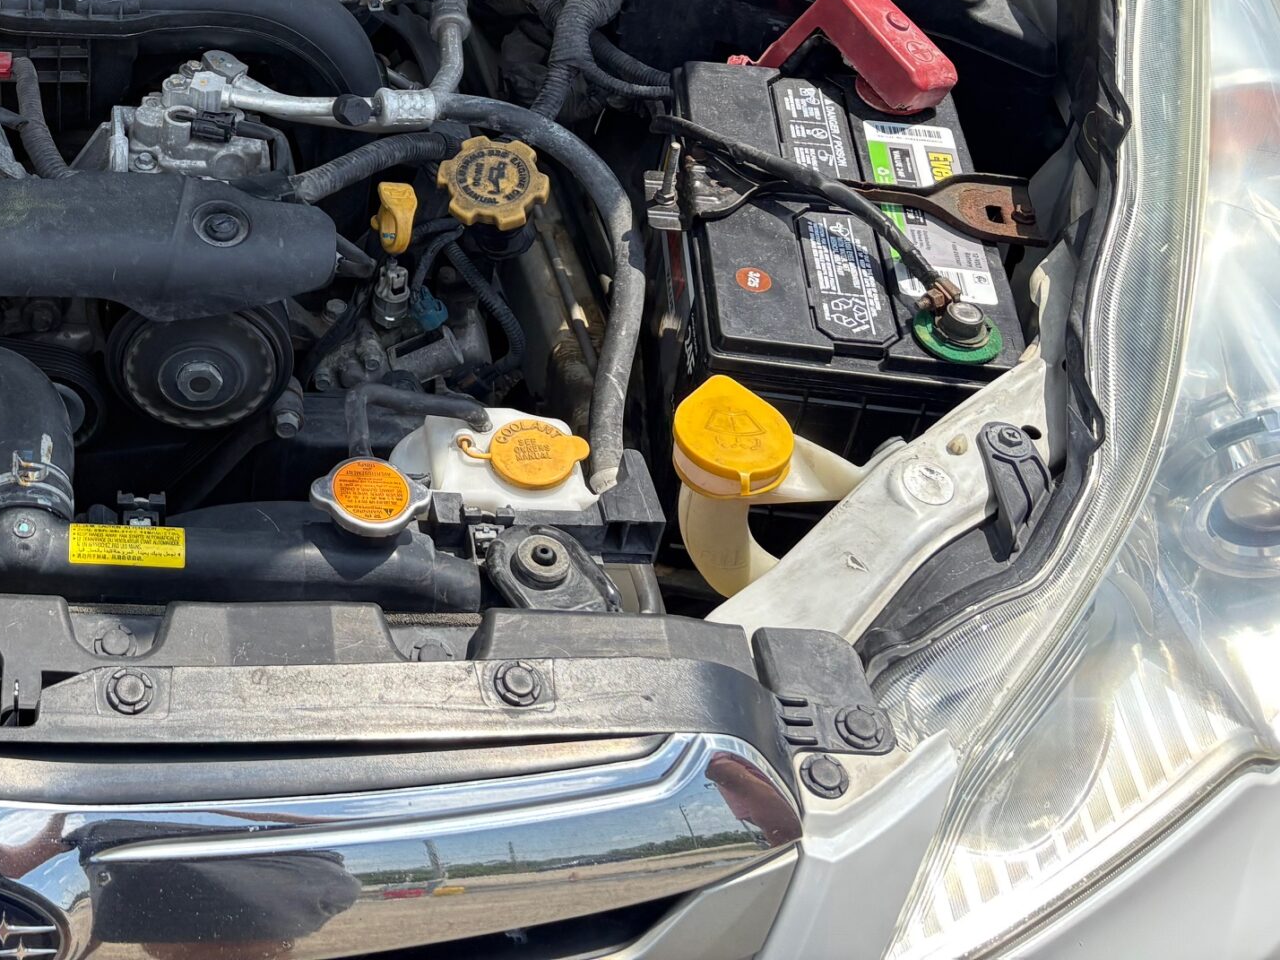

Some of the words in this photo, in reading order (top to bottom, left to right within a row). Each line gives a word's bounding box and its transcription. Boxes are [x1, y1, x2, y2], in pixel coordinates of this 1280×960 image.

[826, 106, 840, 134] DANGER
[834, 141, 847, 167] POISON
[510, 157, 527, 189] ENGINE
[503, 189, 523, 201] OIL
[495, 421, 563, 444] COOLANT
[515, 451, 552, 462] MANUAL
